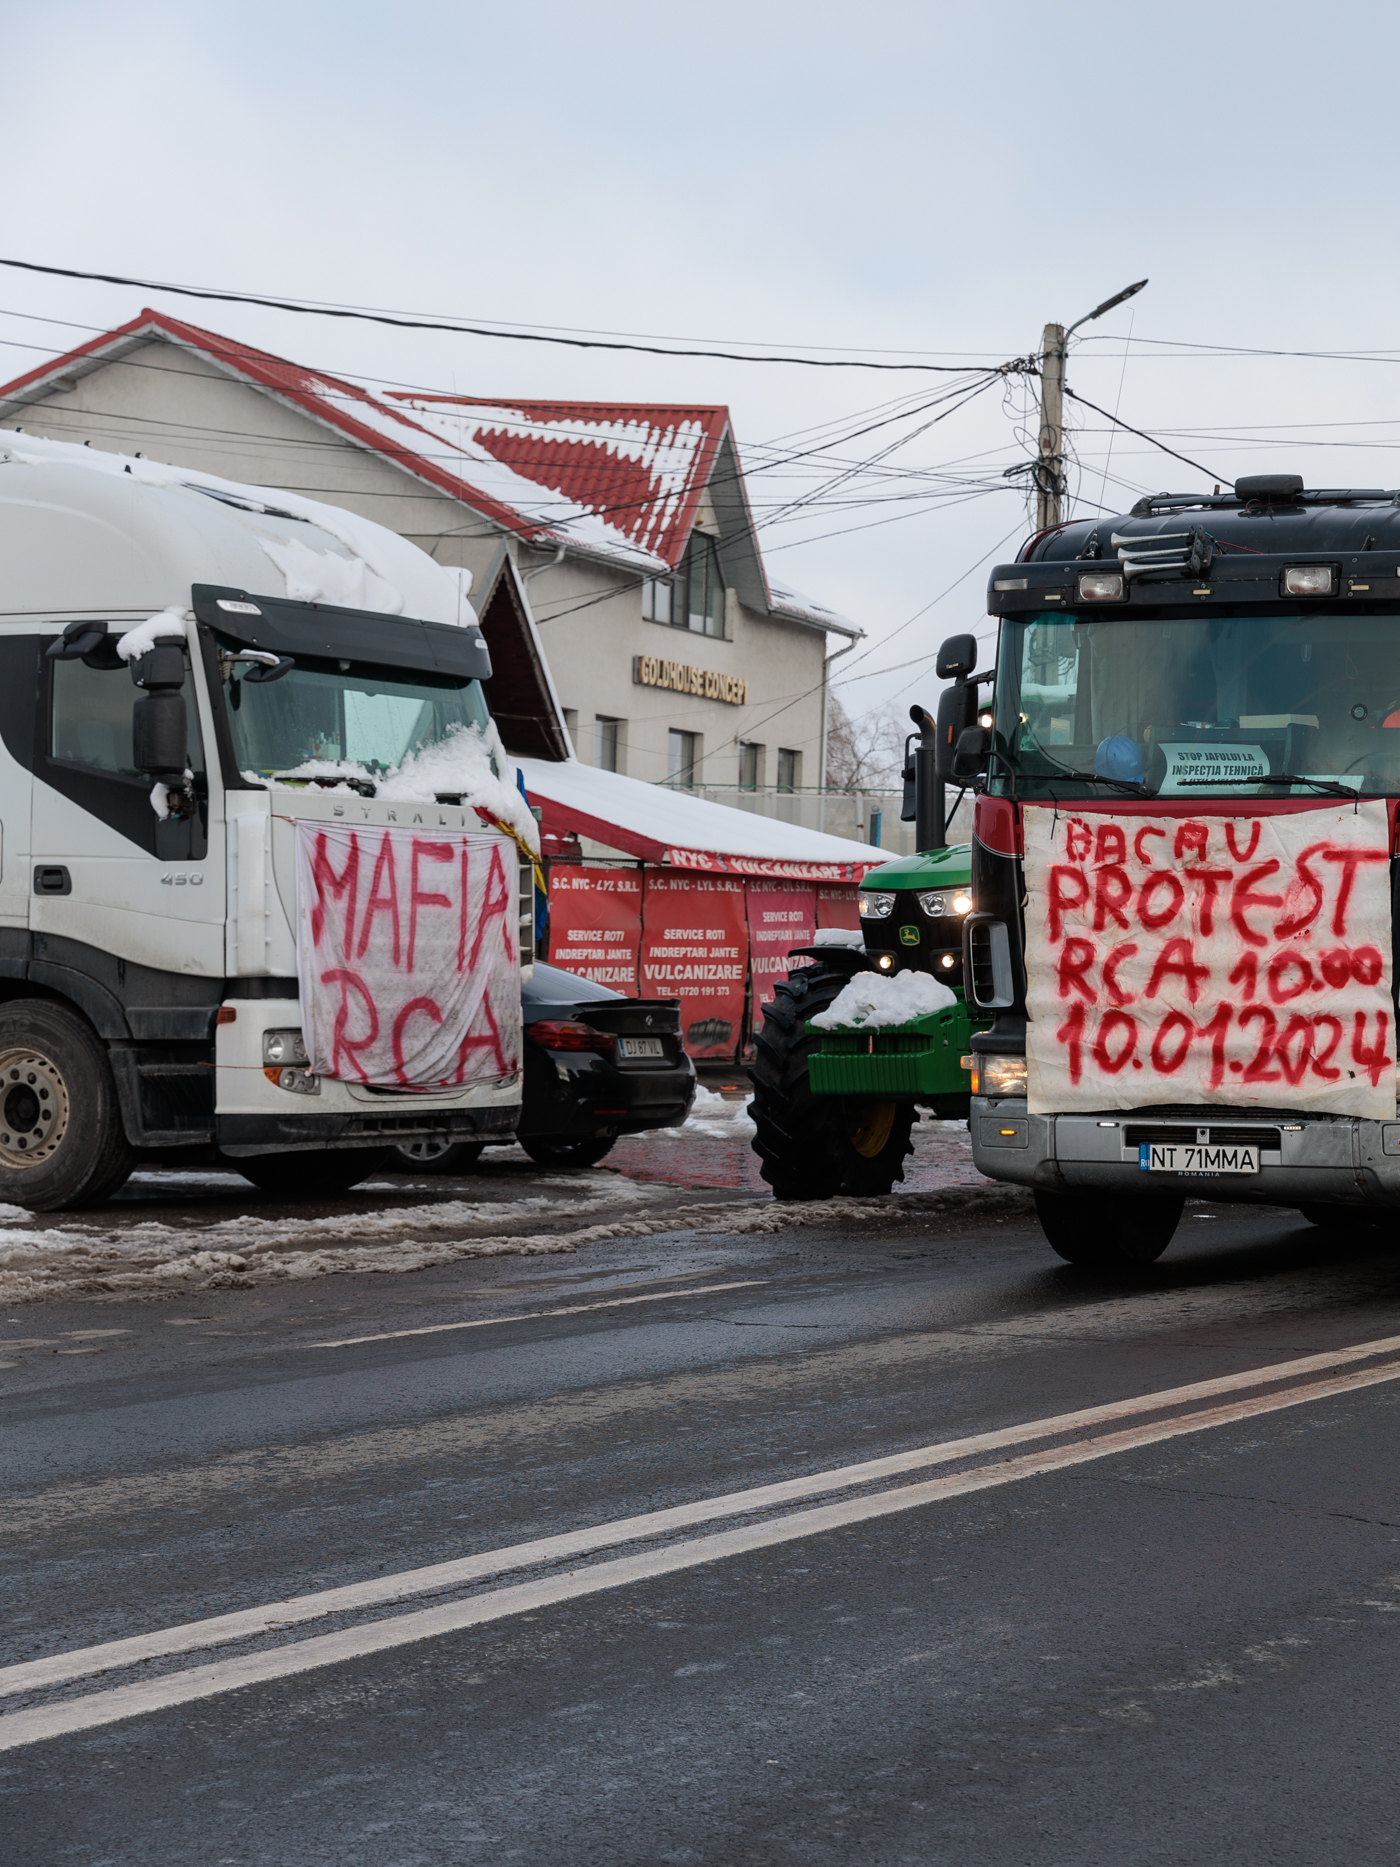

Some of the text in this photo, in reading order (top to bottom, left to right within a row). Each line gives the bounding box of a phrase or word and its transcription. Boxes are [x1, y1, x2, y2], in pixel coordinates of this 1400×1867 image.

[641, 655, 749, 705] GOLDHOUSE CONCEPT
[1178, 752, 1255, 762] STOP JAFULUI LA
[1066, 818, 1262, 864] BACAU
[672, 850, 713, 868] NYC
[730, 858, 841, 879] VULCANIZARE
[161, 872, 204, 886] 450
[552, 877, 570, 889] S.C.
[572, 878, 590, 890] NYC
[649, 879, 668, 890] S.C.
[670, 880, 690, 891] NYC
[697, 880, 715, 891] LYL
[762, 882, 777, 892] NYC
[1047, 842, 1390, 945] PROTEST
[312, 829, 513, 972] MAFIA
[763, 911, 804, 922] SERVICE ROTI
[567, 930, 625, 941] SERVICE ROTI
[664, 929, 725, 940] SERVICE ROTI
[756, 930, 810, 941] INDREPTARI JANTE
[555, 949, 632, 960] INDREPTARI JANTE
[649, 947, 739, 958] INDREPTARI JANTE
[644, 964, 743, 980] VULCANIZARE
[1057, 938, 1210, 1006] RCA
[679, 986, 699, 996] 0720
[701, 987, 715, 996] 191
[716, 987, 730, 996] 373
[320, 968, 509, 1091] RCA
[626, 1041, 660, 1054] DJ 87 VL
[1057, 1001, 1392, 1090] 10.01.2024
[1152, 1147, 1255, 1170] NT 71MMA
